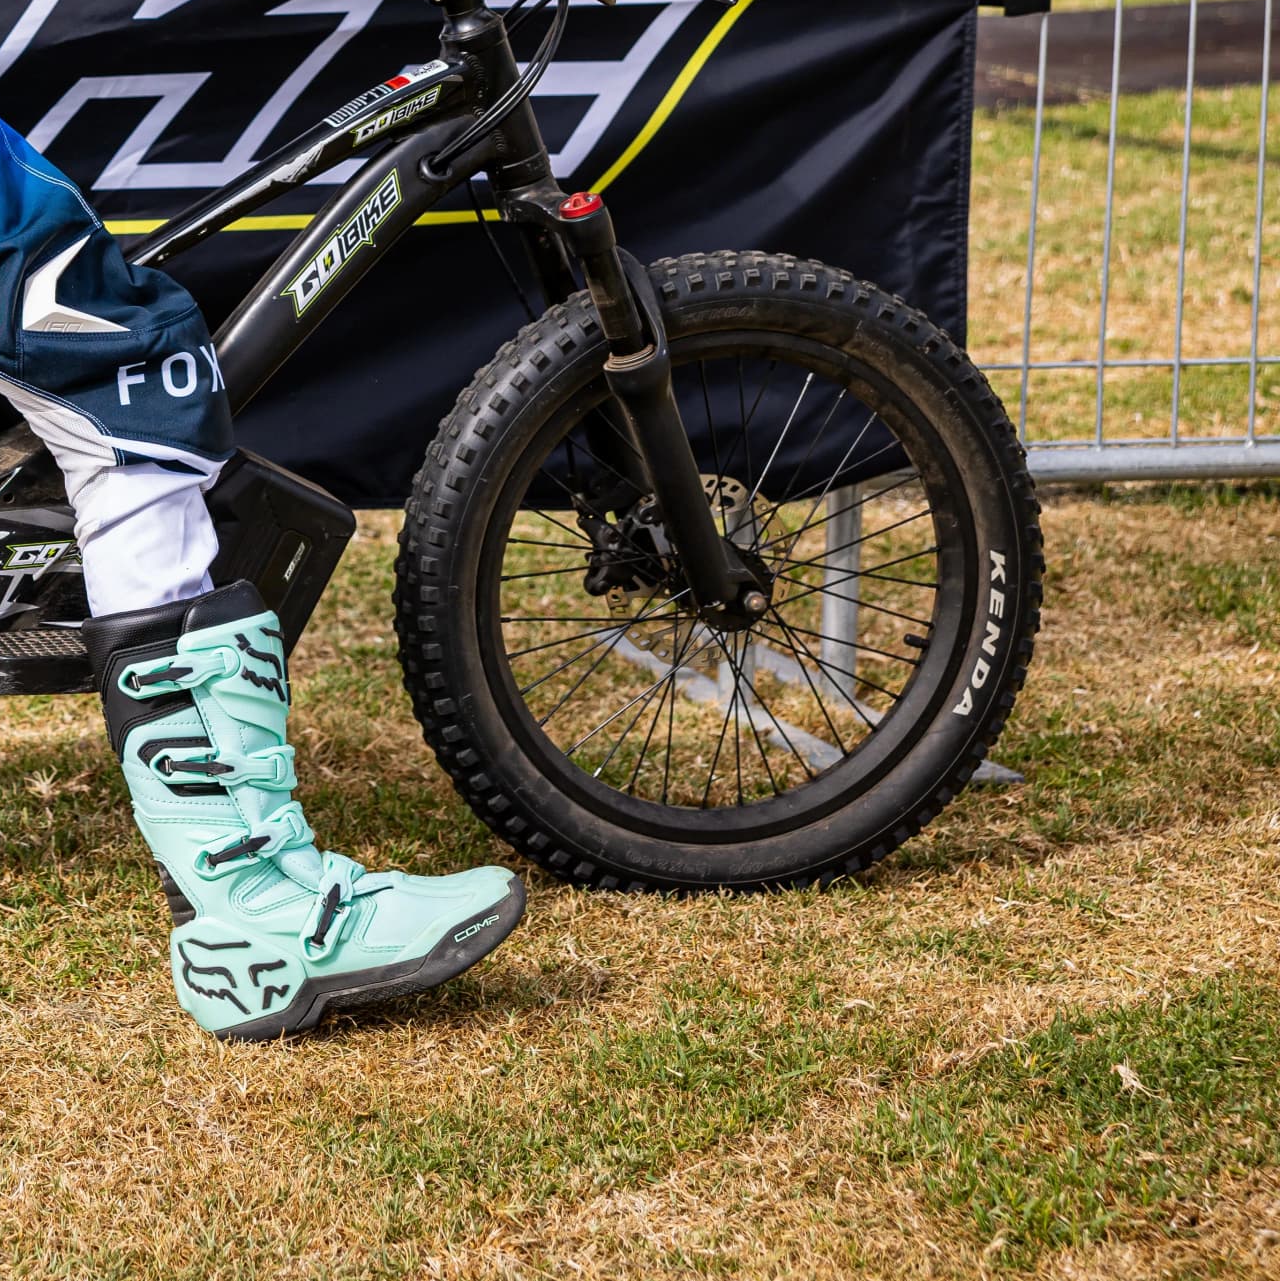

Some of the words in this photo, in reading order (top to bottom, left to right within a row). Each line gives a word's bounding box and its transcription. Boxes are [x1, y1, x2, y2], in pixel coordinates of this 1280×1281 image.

[287, 172, 400, 313] GOBIKE
[117, 342, 226, 406] FOX
[951, 549, 1008, 717] KENDA
[454, 914, 500, 943] COMP
